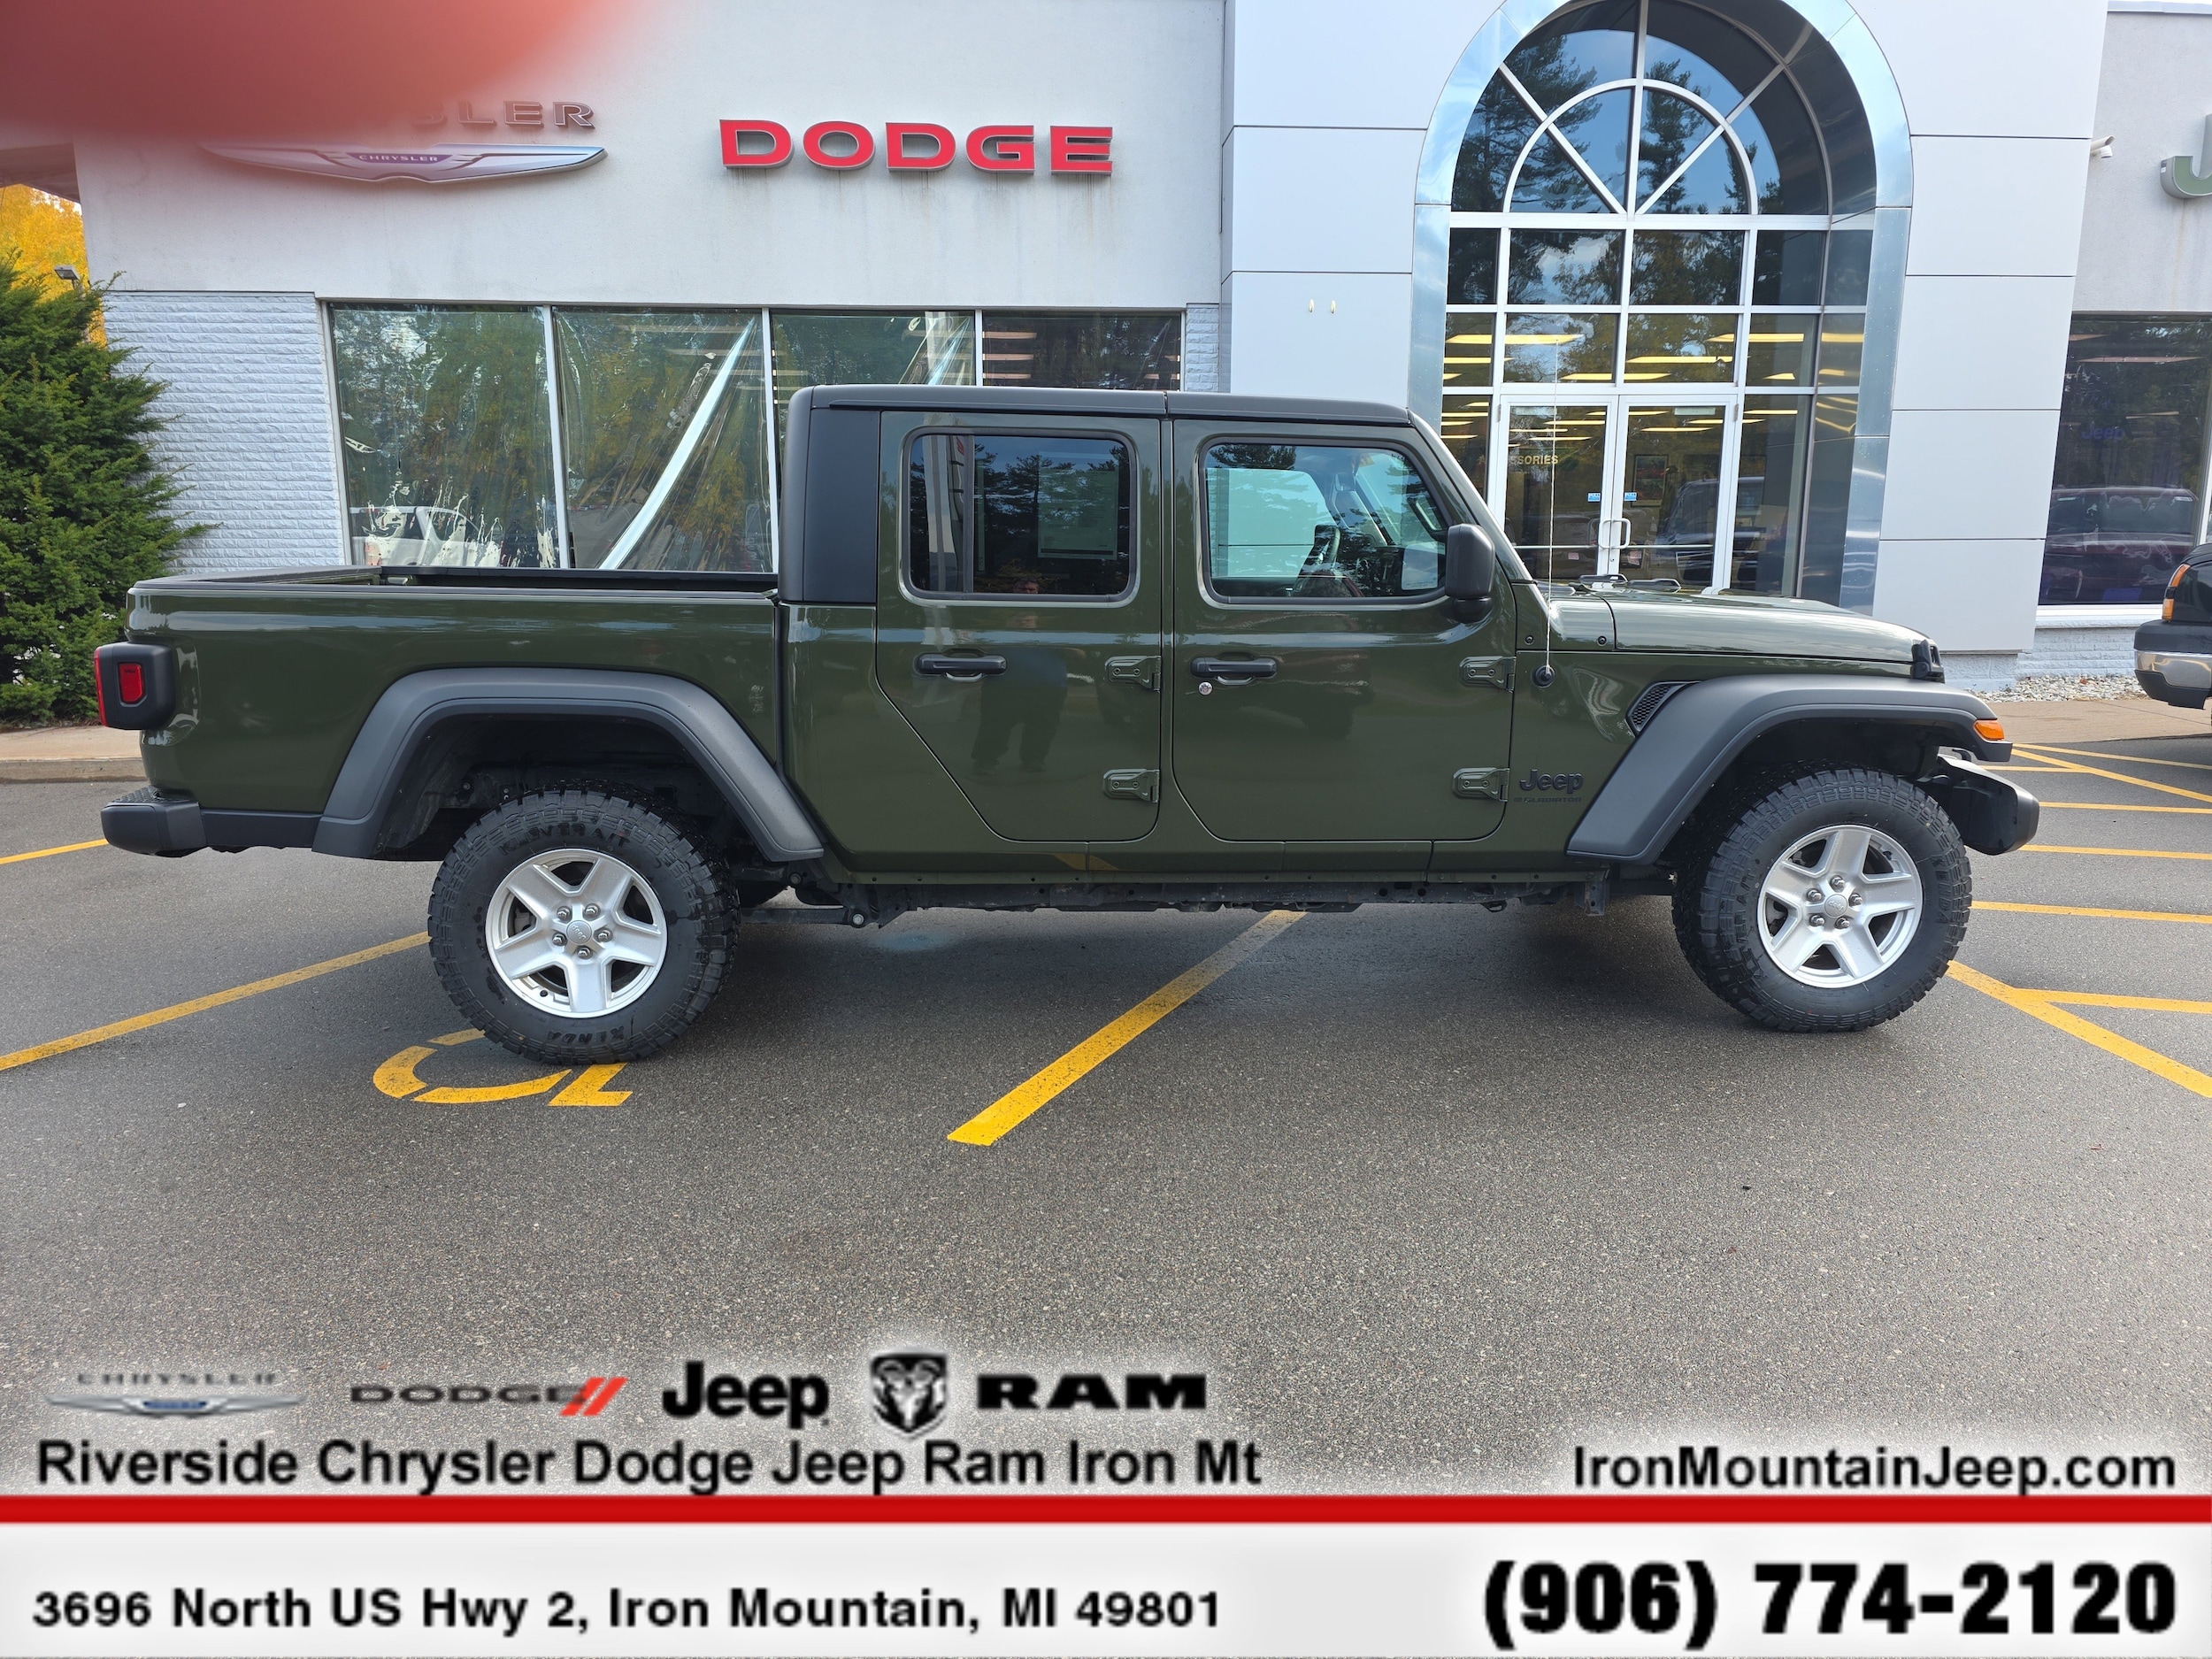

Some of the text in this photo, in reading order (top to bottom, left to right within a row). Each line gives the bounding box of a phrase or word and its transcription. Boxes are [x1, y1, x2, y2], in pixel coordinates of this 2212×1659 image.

[358, 154, 439, 163] CHRYSLER
[719, 119, 1113, 177] DODGE
[1519, 769, 1584, 794] Jeep
